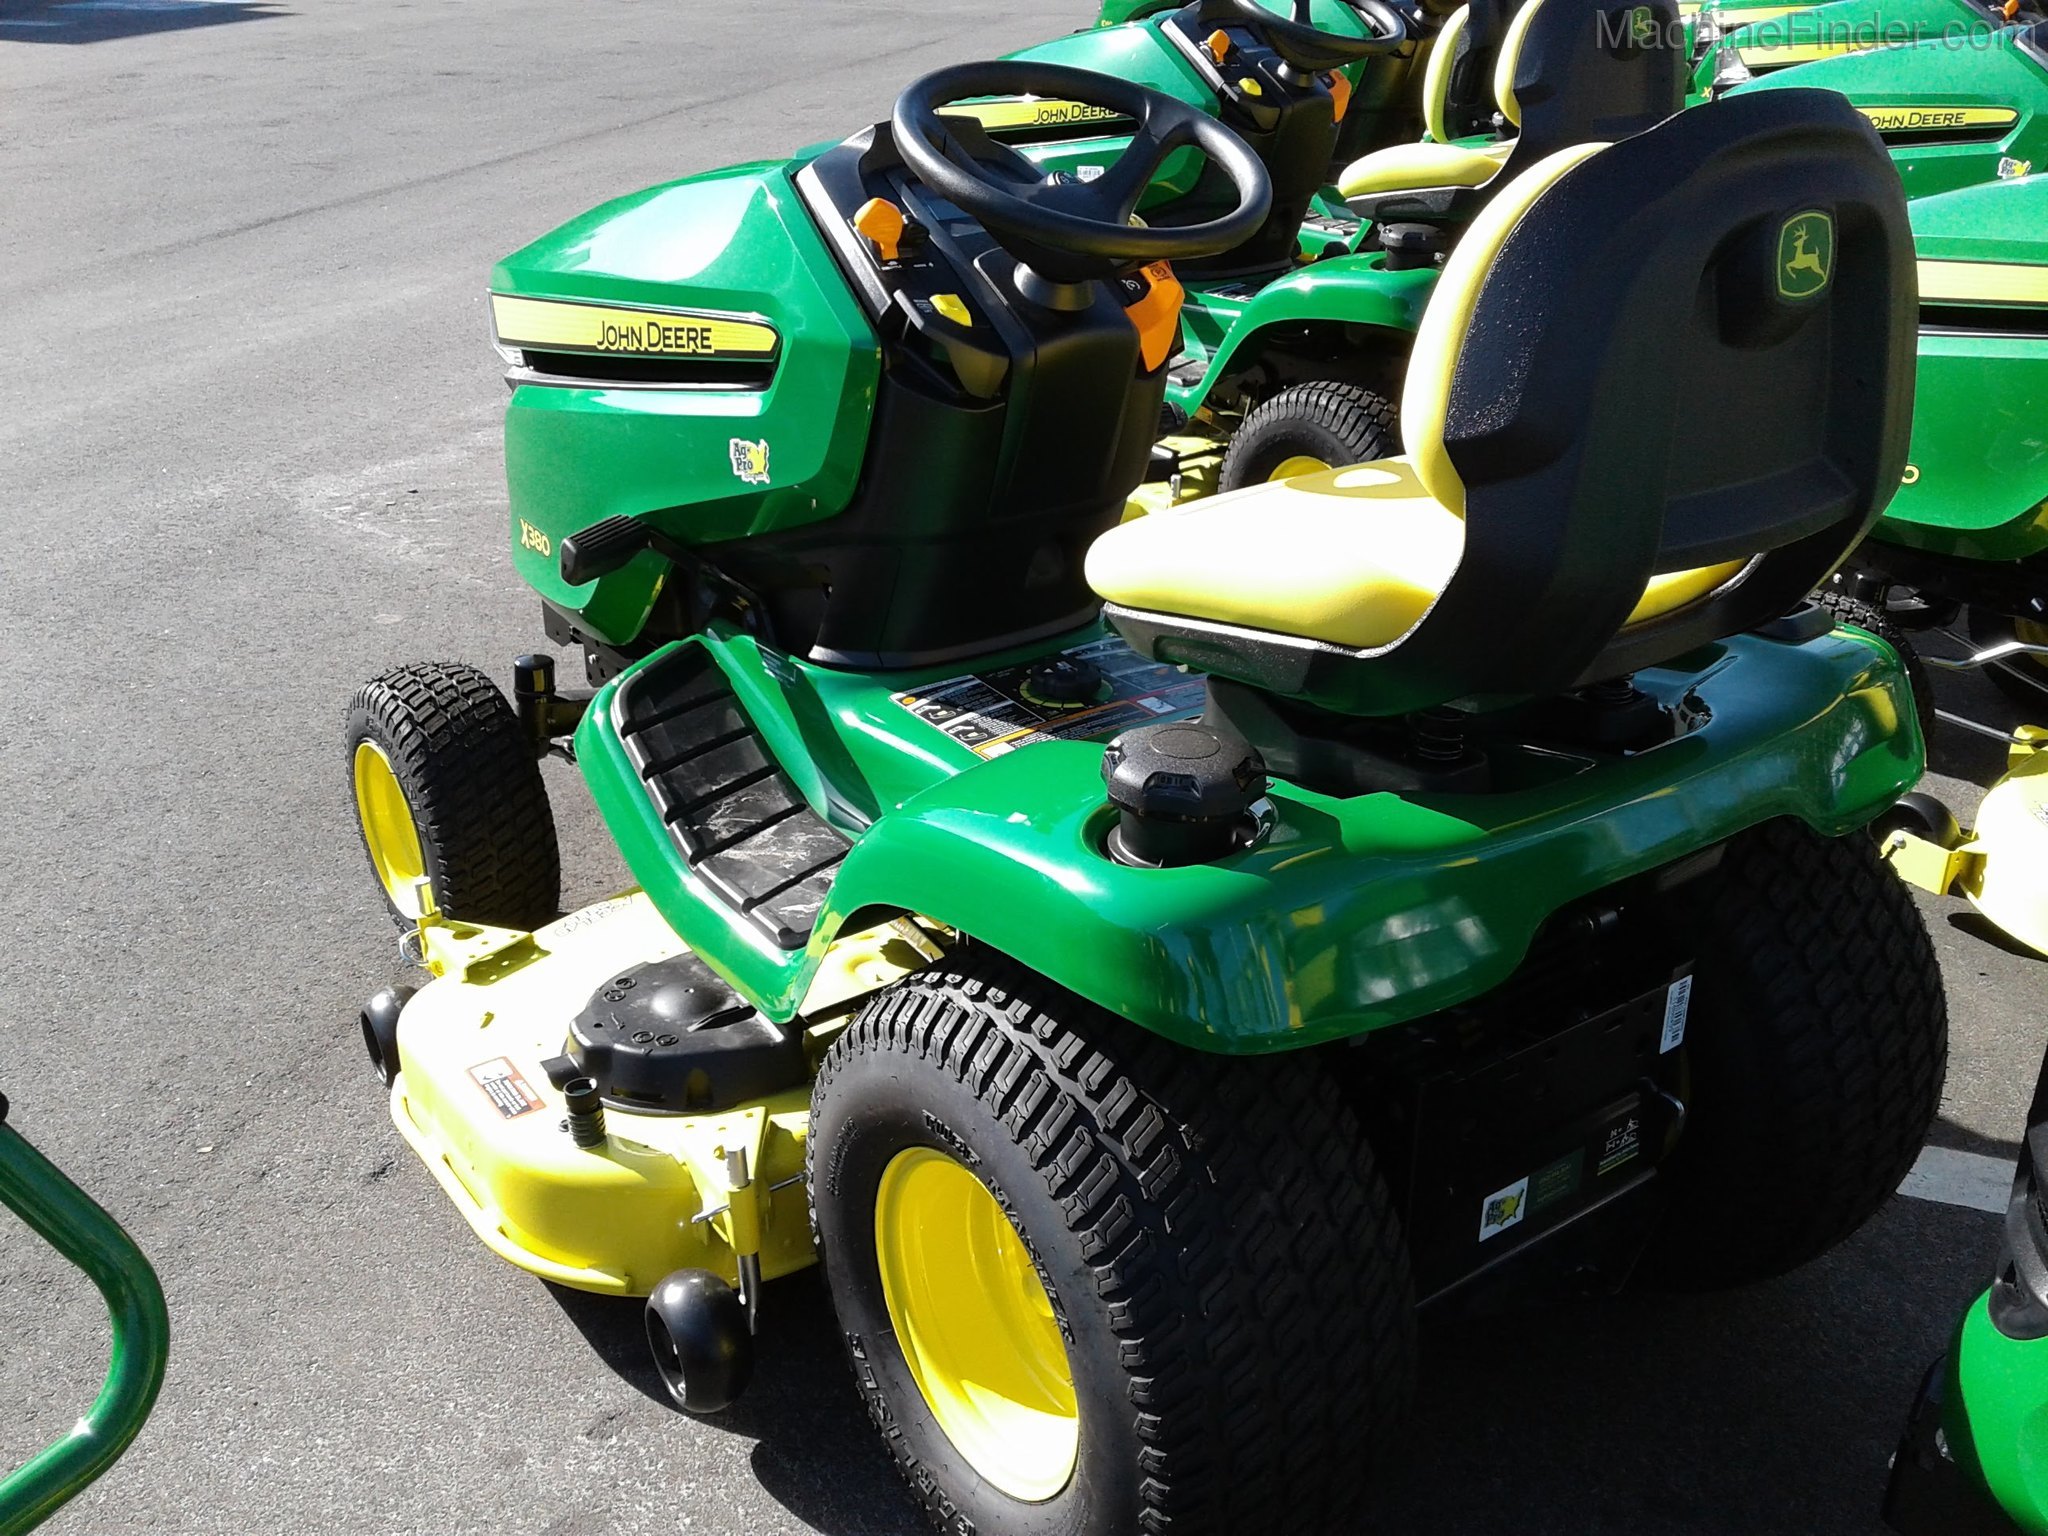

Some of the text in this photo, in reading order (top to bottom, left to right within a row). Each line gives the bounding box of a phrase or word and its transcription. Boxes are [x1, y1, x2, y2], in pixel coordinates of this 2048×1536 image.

[1033, 107, 1068, 123] JOHN
[1867, 112, 1966, 128] OHN DEERE
[596, 320, 713, 350] JOHN DEERE
[735, 457, 753, 471] Pro
[519, 517, 551, 557] X380
